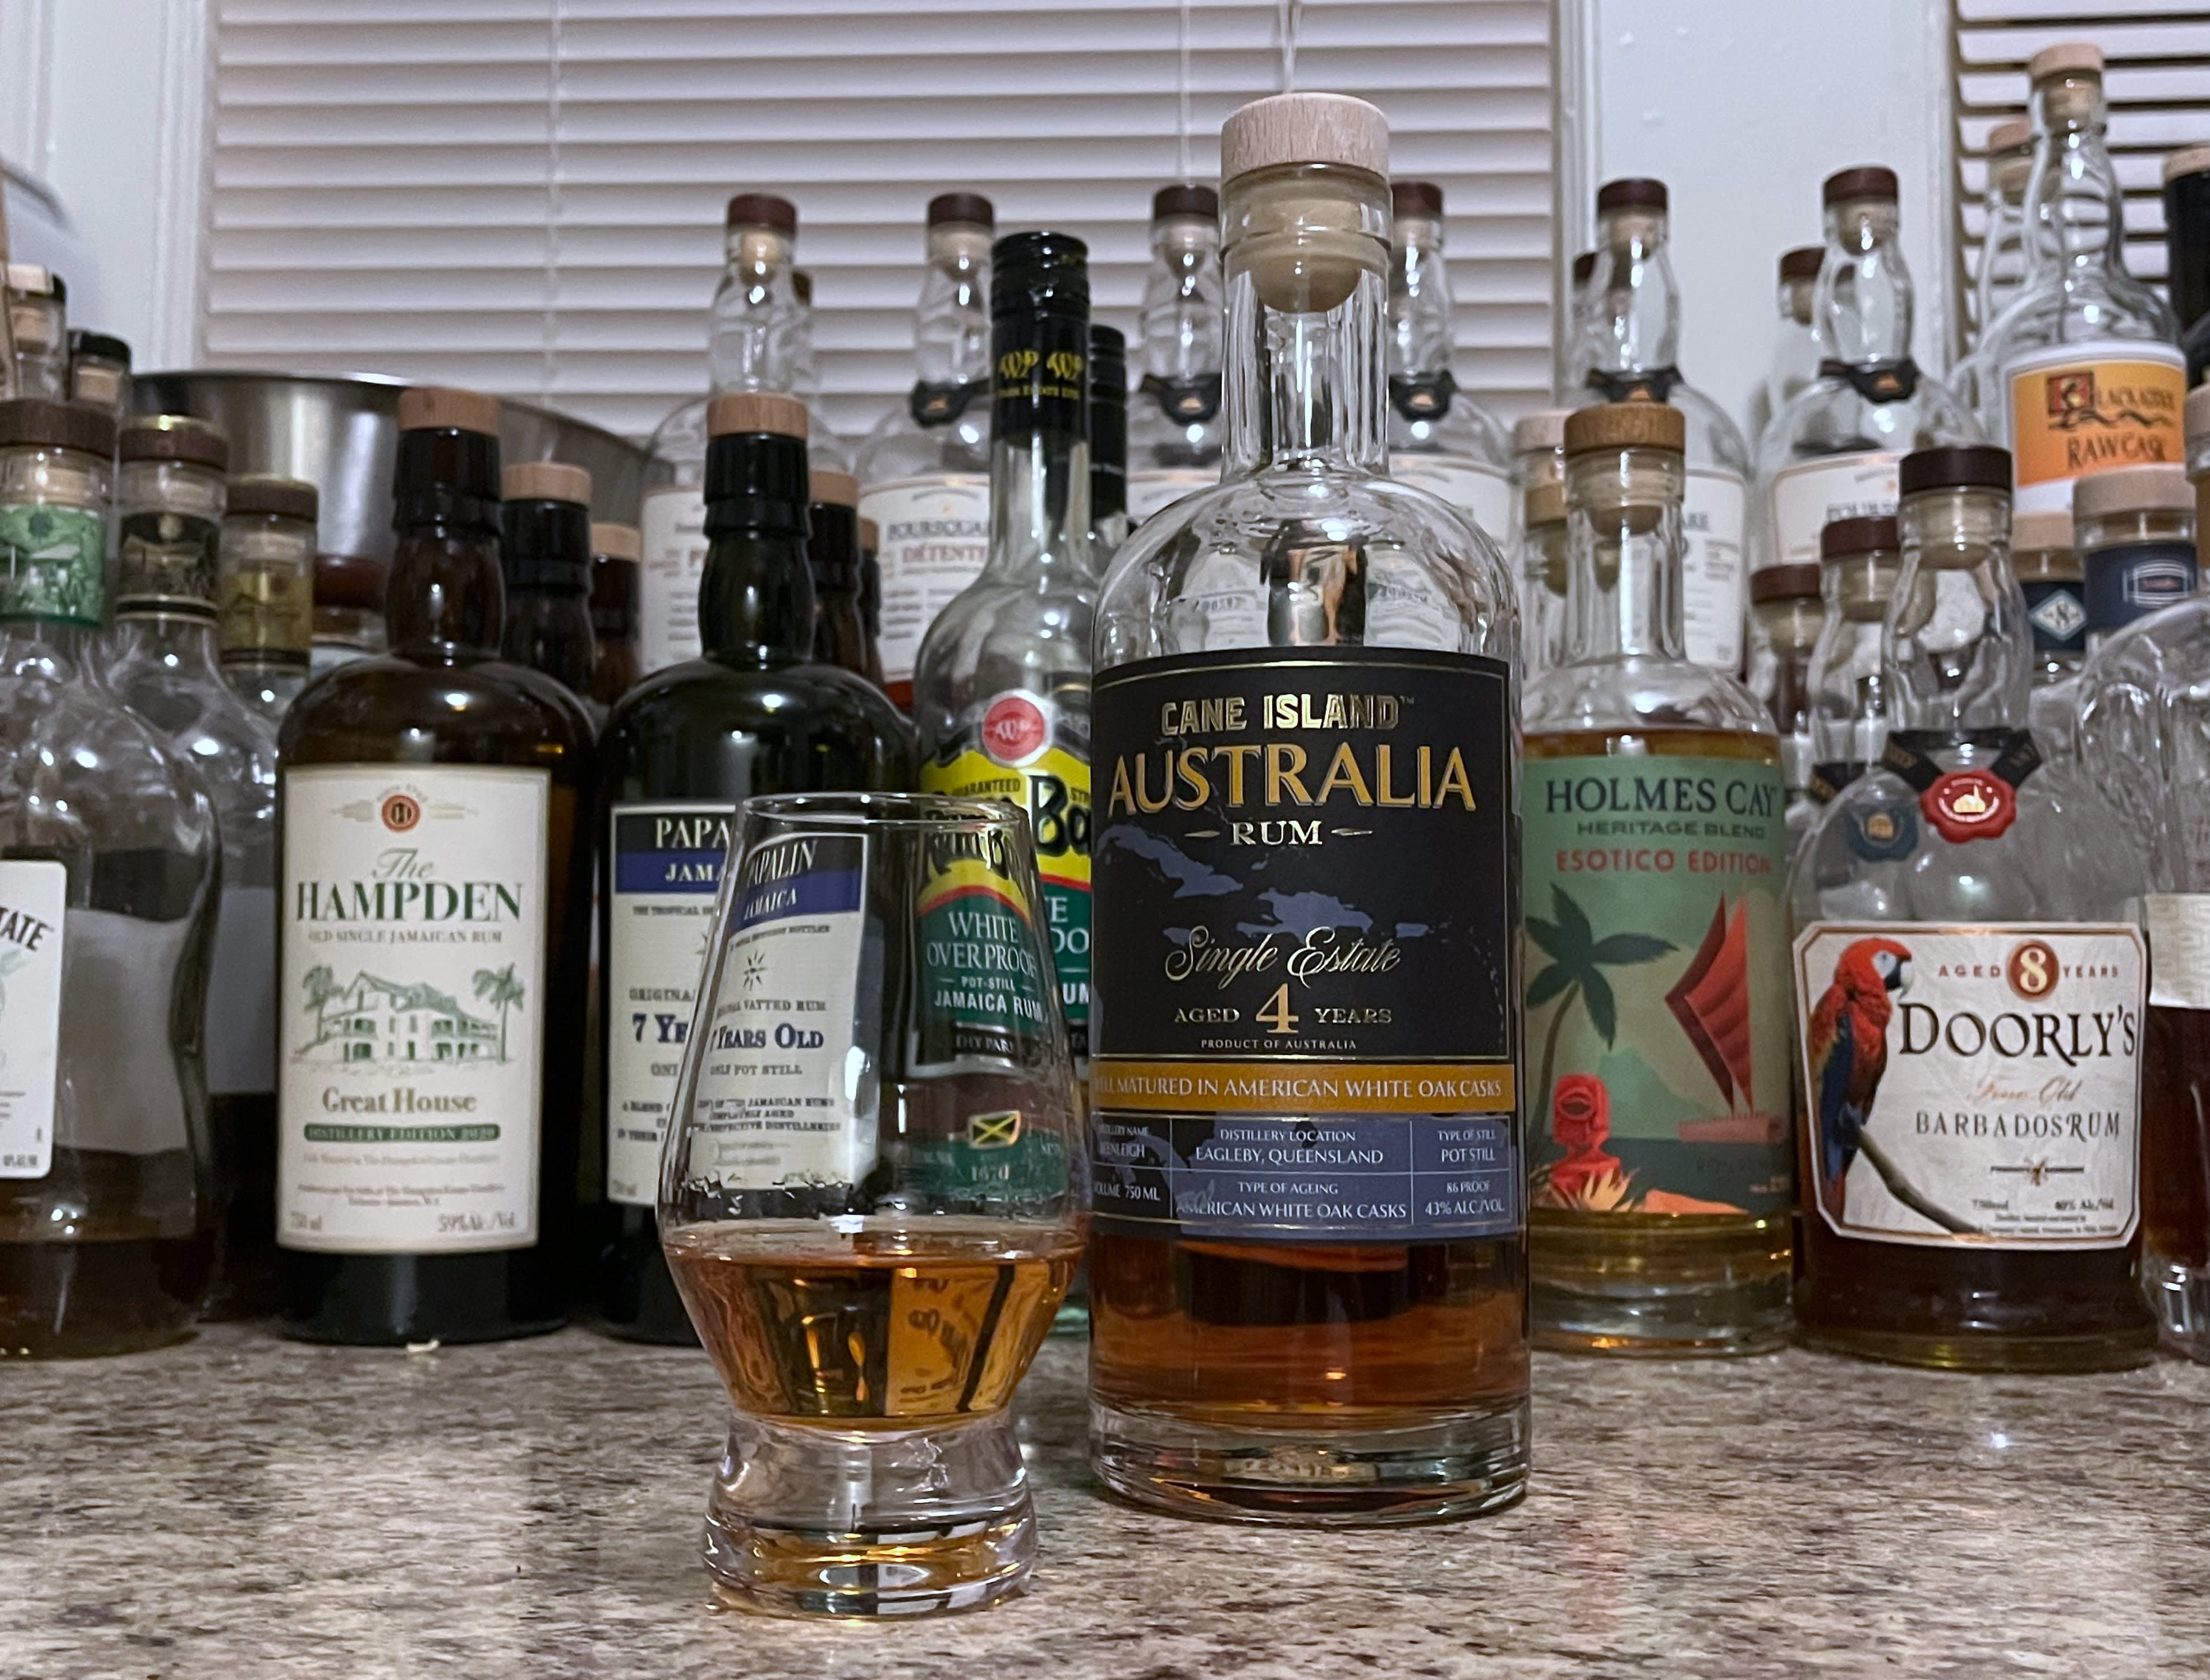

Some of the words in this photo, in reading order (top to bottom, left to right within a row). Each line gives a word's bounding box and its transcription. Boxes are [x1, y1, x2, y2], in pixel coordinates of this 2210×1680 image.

[1161, 696, 1248, 737] CANE
[1107, 741, 1477, 818] AUSTRALIA
[1545, 777, 1717, 814] HOLMES
[1725, 780, 1777, 818] CAY
[1229, 820, 1323, 846] RUM
[1576, 820, 1699, 837] HERITAGE
[1704, 822, 1767, 840] BLEND
[372, 847, 434, 880] The
[1556, 849, 1675, 873] ESOTICO
[1687, 850, 1774, 876] EDITION
[296, 881, 524, 922] HAMPDEN
[308, 930, 332, 942] OLD
[336, 930, 385, 943] SINGLE
[390, 930, 467, 943] JAMAICAN
[472, 930, 502, 942] RUM
[947, 910, 1019, 943] WHITE
[1165, 925, 1279, 990] Single
[1286, 926, 1402, 988] Estate
[1938, 965, 2001, 978] AGED
[2019, 948, 2048, 994] 8
[2063, 965, 2119, 979] YEARS
[744, 1000, 792, 1011] VATTED
[796, 1000, 826, 1011] RUM
[934, 990, 1007, 1014] JAMAICA
[1174, 1007, 1241, 1023] AGED
[1255, 982, 1300, 1034] 4
[1314, 1007, 1392, 1024] YEARS
[632, 1013, 647, 1042] 7
[1898, 1002, 2135, 1067] DOORLY'S
[1201, 1039, 1259, 1050] PRODUCT
[1263, 1039, 1279, 1050] OF
[1285, 1039, 1357, 1050] AUSTRALIA
[323, 1086, 387, 1114] Great
[393, 1087, 477, 1114] House
[1118, 1077, 1193, 1096] MATURED
[1198, 1078, 1219, 1096] IN
[1223, 1078, 1340, 1098] AMERICAN
[1344, 1080, 1413, 1099] WHITE
[1418, 1079, 1457, 1098] OAK
[1459, 1079, 1502, 1098] CASKS
[1219, 1129, 1286, 1142] DISTILLERY
[1289, 1130, 1357, 1142] LOCATION
[1437, 1129, 1461, 1142] TYPE
[1462, 1129, 1475, 1141] OF
[1476, 1129, 1496, 1140] STILL
[1916, 1111, 2063, 1138] BARBADOS
[2066, 1111, 2120, 1143] RUM
[1195, 1147, 1265, 1165] EAGLEBY,
[1268, 1148, 1384, 1166] QUEENSLAND
[1441, 1148, 1468, 1163] POT
[1469, 1148, 1496, 1163] STILL
[1125, 1184, 1141, 1200] 750
[1142, 1186, 1161, 1201] ML
[1237, 1181, 1266, 1194] TYPE
[1269, 1182, 1288, 1194] OF
[1290, 1182, 1339, 1195] AGEING
[1446, 1182, 1459, 1194] 86
[1460, 1180, 1491, 1194] PROOF
[1176, 1200, 1257, 1217] AMERICAN
[1258, 1202, 1314, 1219] WHITE
[1316, 1203, 1353, 1219] OAK
[1356, 1203, 1407, 1219] CASKS
[1424, 1201, 1452, 1216] 43%
